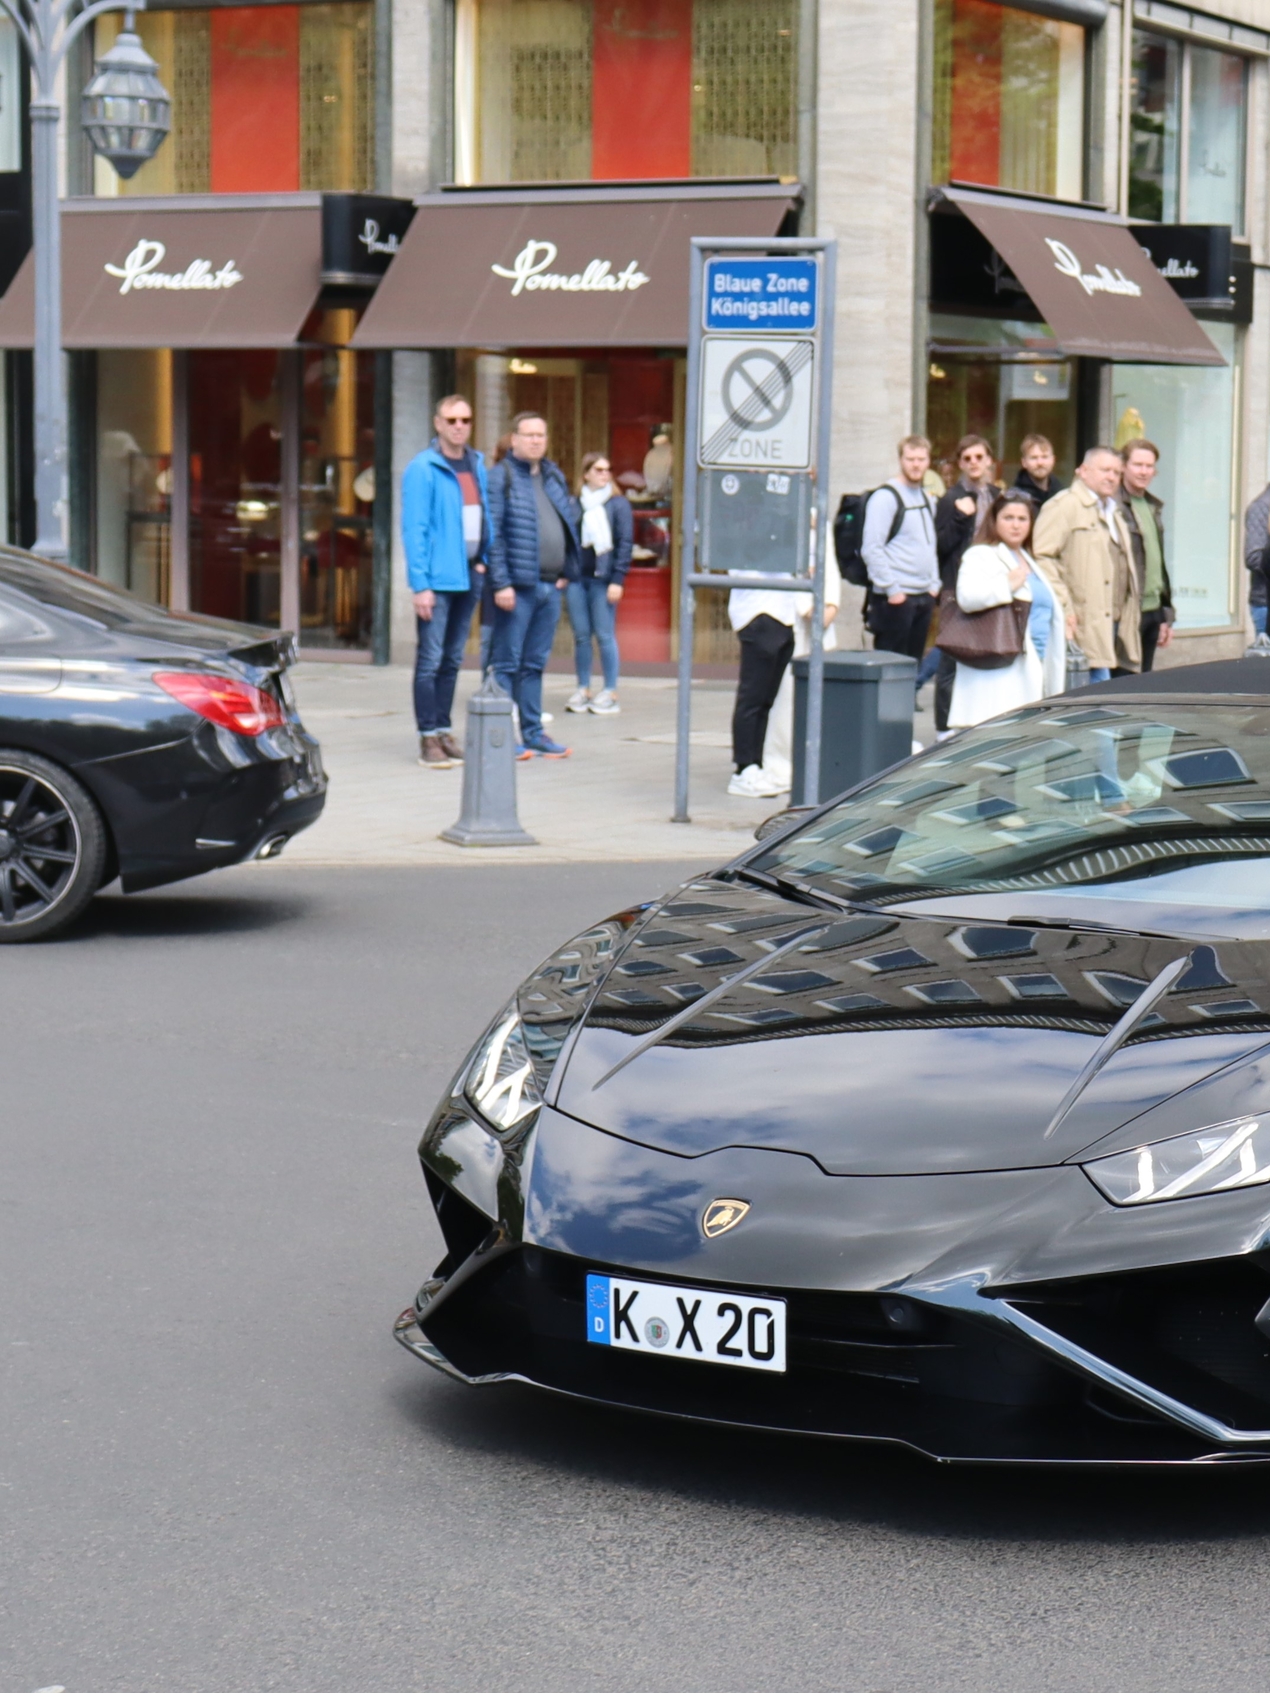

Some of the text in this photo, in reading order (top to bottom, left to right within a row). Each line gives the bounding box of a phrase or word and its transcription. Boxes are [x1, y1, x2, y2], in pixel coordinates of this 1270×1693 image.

[358, 218, 399, 254] Pomell
[104, 239, 243, 294] Pomellato
[491, 239, 650, 296] Pomellato
[714, 273, 809, 293] Blaue Zone
[1044, 237, 1141, 297] Pomellato
[711, 296, 811, 321] Königsallee
[727, 440, 783, 459] ZONE
[593, 1317, 605, 1333] D
[613, 1287, 640, 1343] K
